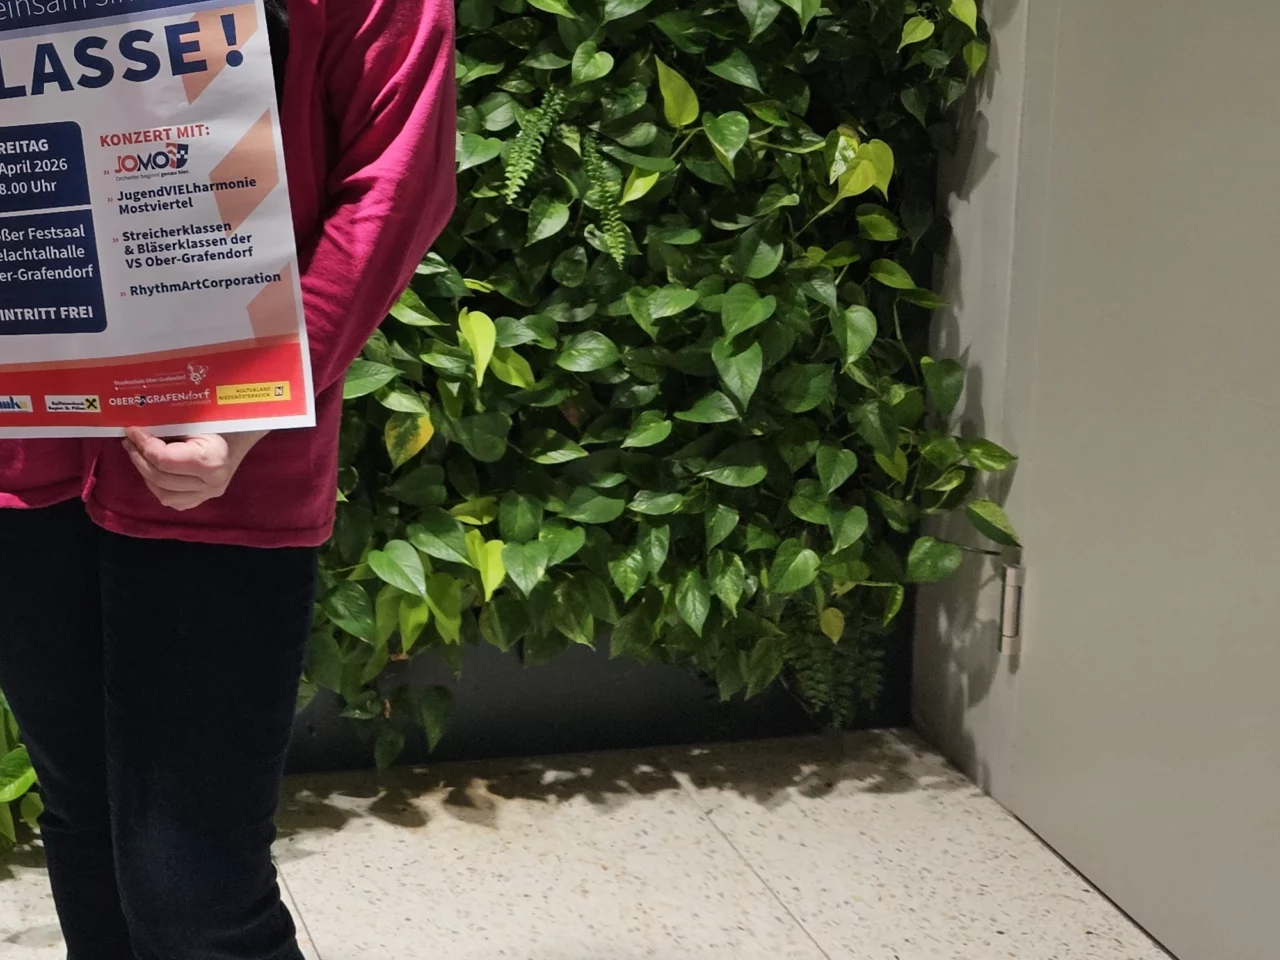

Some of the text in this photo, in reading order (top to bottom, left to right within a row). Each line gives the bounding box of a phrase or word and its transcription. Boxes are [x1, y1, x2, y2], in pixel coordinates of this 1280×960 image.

[99, 124, 211, 148] KONZERT MIT:
[34, 158, 68, 173] 2026
[114, 151, 170, 174] JOMO
[31, 179, 57, 193] Uhr
[117, 177, 257, 203] JugendVIELharmonie
[119, 197, 194, 215] Mostviertel
[27, 224, 85, 241] Festsaal
[122, 222, 232, 242] Streicherklassen
[124, 232, 252, 255] & Bläserklassen der
[125, 246, 253, 269] VS Ober-Grafendorf
[130, 272, 281, 297] RhythmArtCorporation
[60, 306, 94, 320] FREI
[108, 396, 135, 406] OBER
